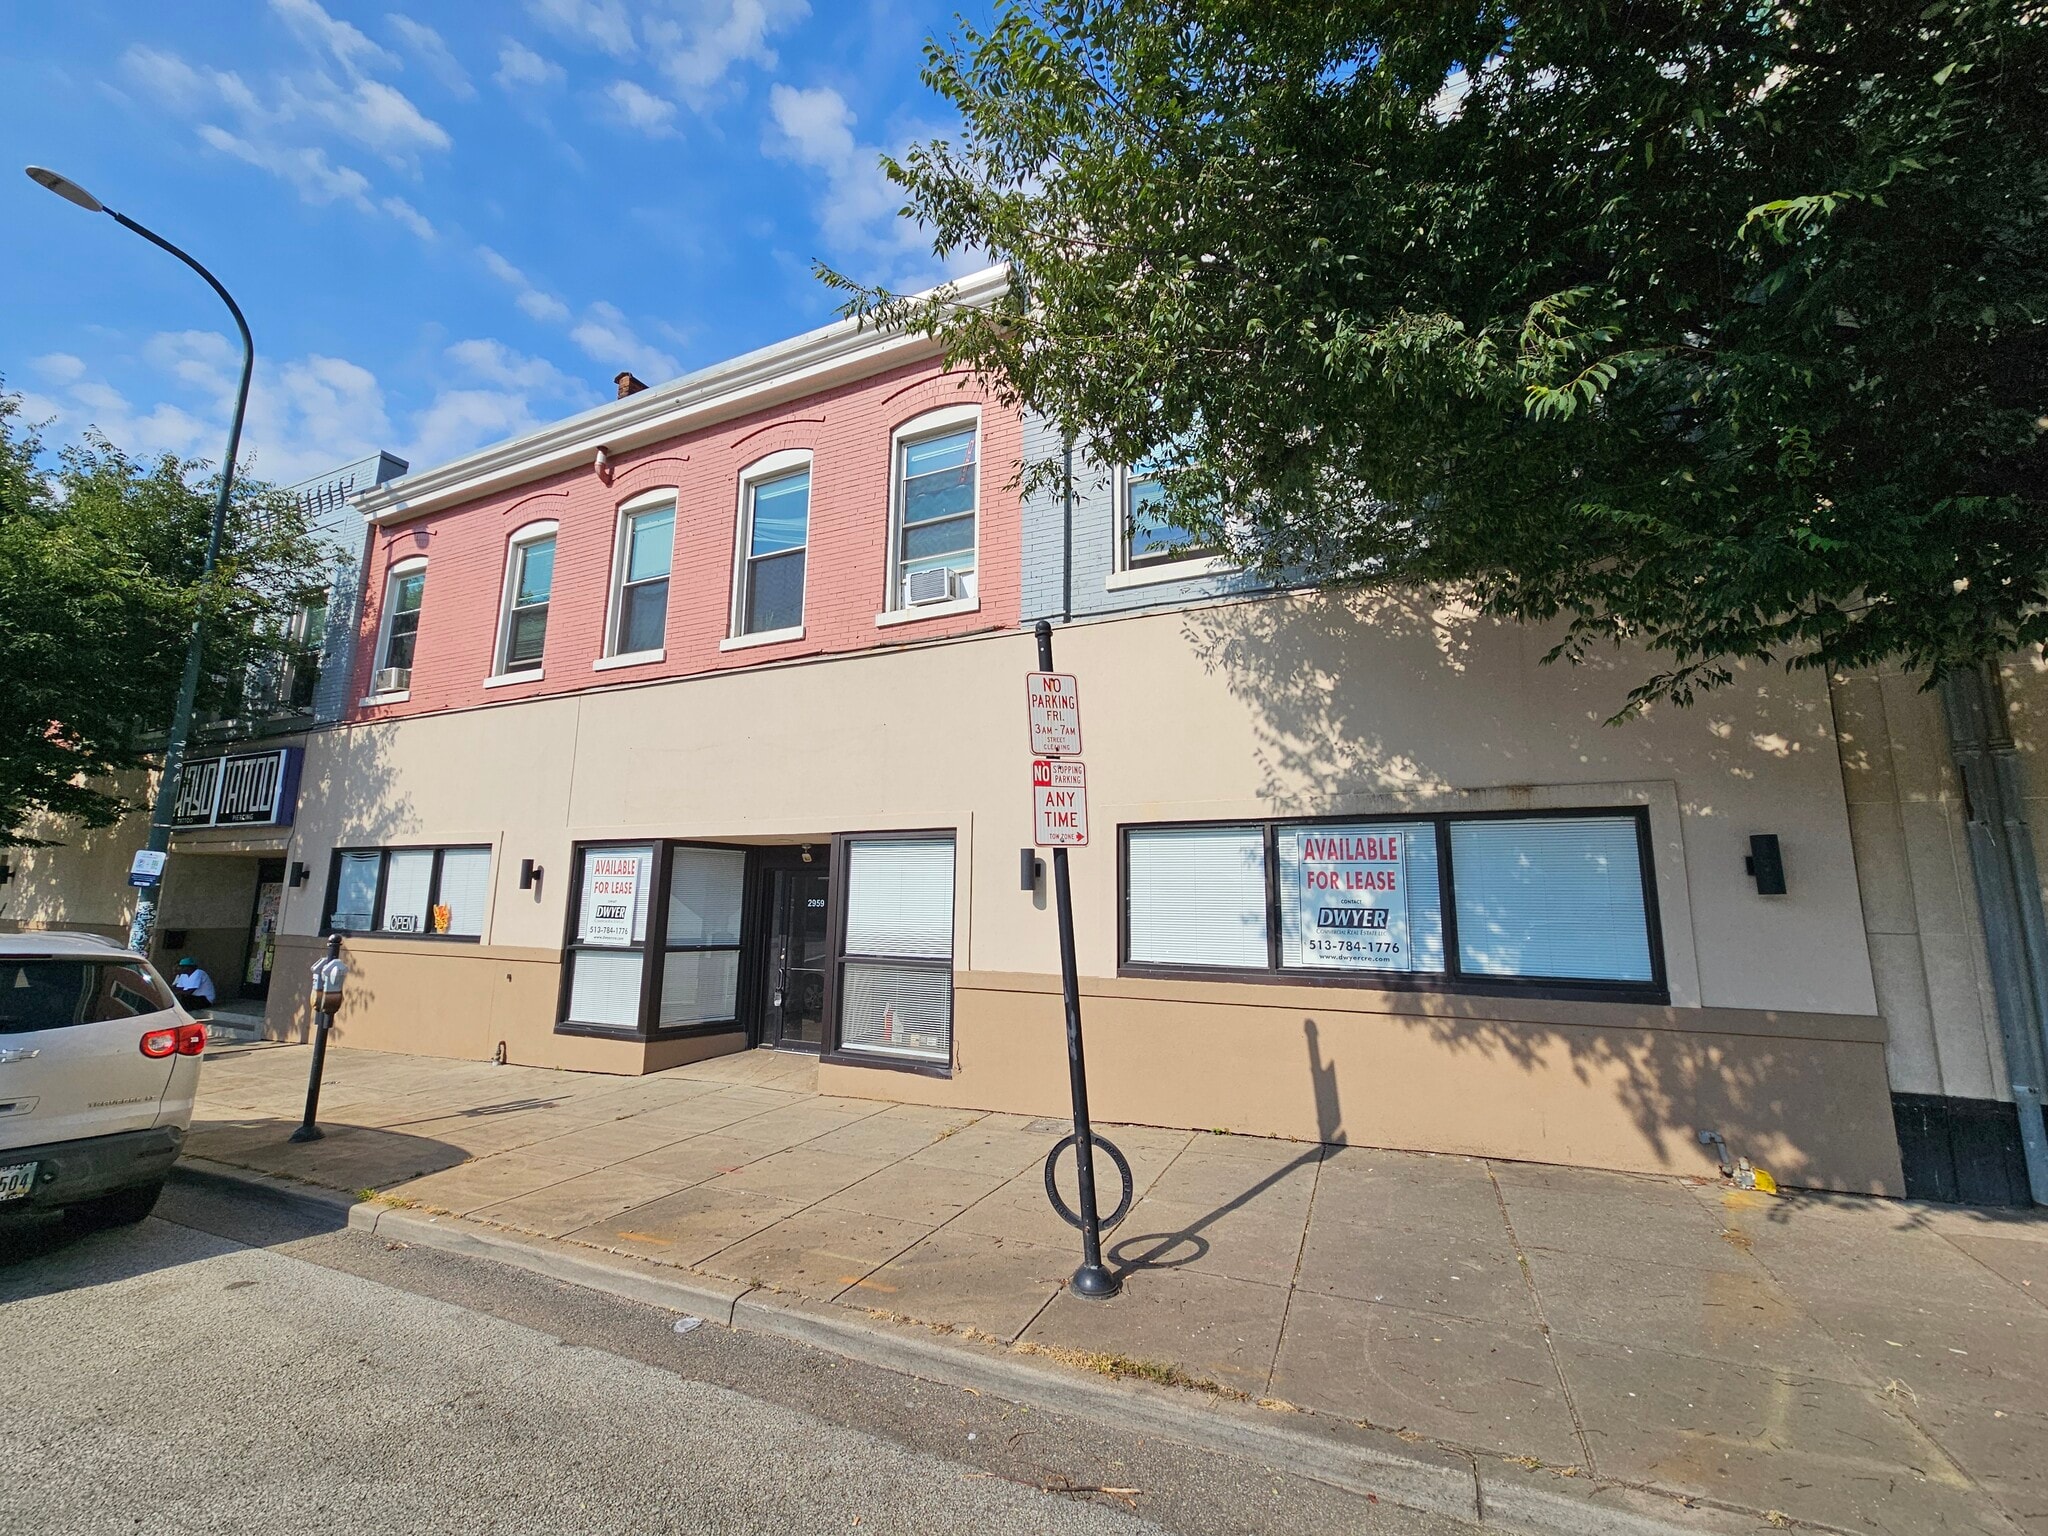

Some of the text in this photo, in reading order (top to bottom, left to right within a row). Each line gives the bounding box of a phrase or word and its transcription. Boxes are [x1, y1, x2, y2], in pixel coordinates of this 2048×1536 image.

[1043, 677, 1062, 693] NO
[1032, 694, 1075, 709] PARKING
[1046, 710, 1065, 721] FRI.
[1035, 723, 1053, 734] 3AM
[1060, 724, 1076, 735] 7AM
[1034, 765, 1050, 782] NO
[1052, 765, 1082, 775] STOPPING
[220, 756, 279, 814] TATTOO
[1054, 775, 1081, 784] PARKING
[1045, 791, 1075, 807] ANY
[1044, 811, 1078, 828] TIME
[1304, 837, 1398, 861] AVAILABLE
[594, 859, 636, 875] AVAILABLE
[594, 881, 633, 894] FOR LEASE
[1307, 871, 1396, 890] FOR LEASE
[807, 899, 825, 908] 2959
[596, 906, 626, 918] DWYER
[1319, 909, 1386, 928] DWYER
[391, 916, 415, 930] OPEN
[590, 926, 629, 935] 513-784-1776
[1309, 940, 1400, 954] 513-784-1776
[1319, 954, 1391, 963] www.dwyercre.com
